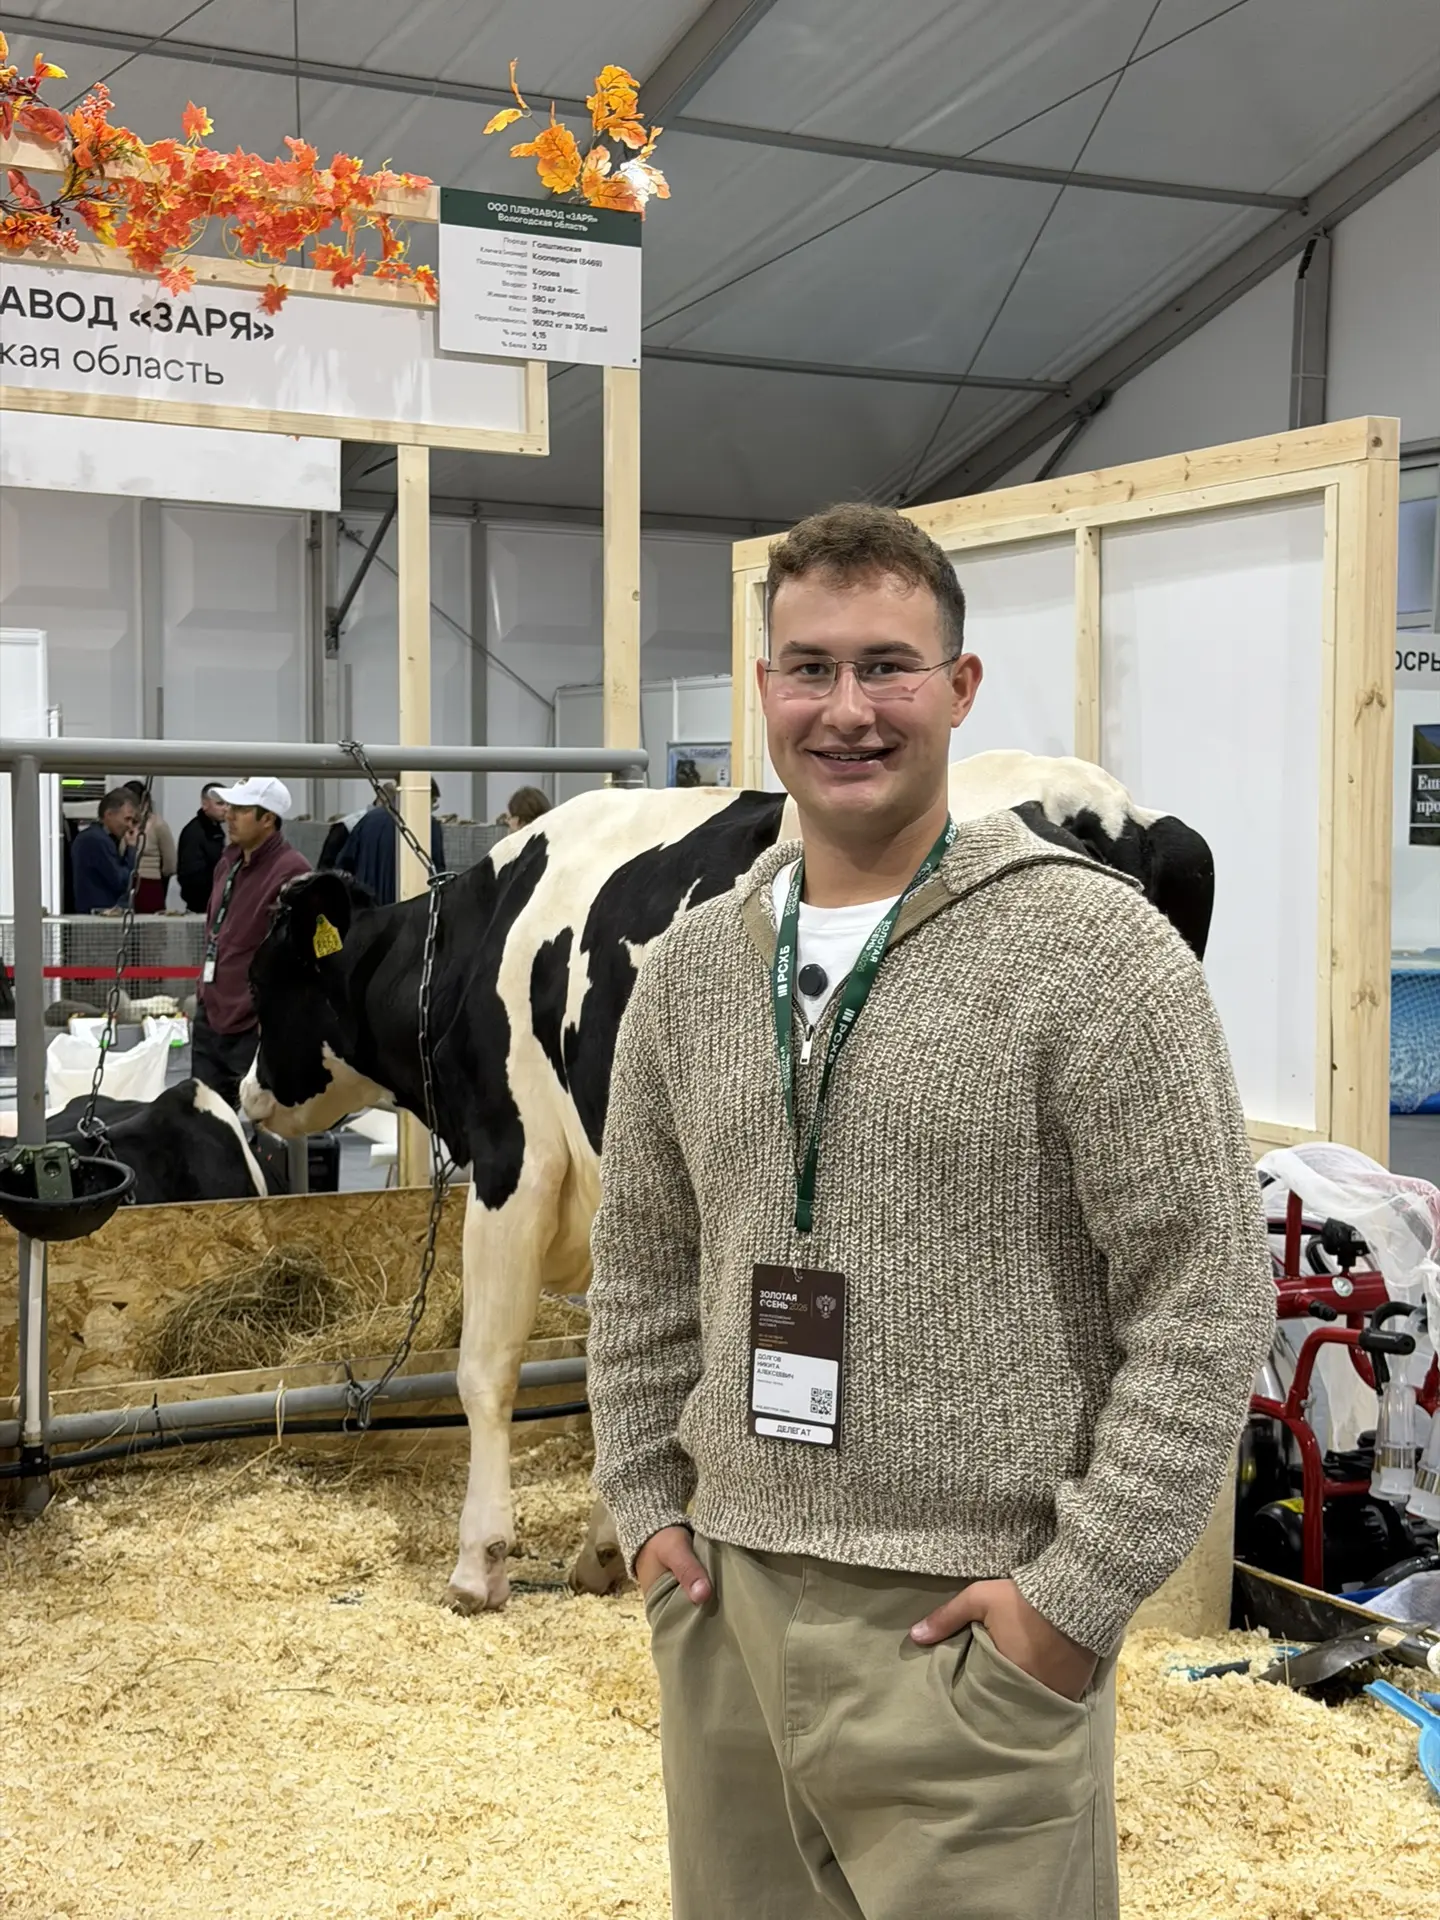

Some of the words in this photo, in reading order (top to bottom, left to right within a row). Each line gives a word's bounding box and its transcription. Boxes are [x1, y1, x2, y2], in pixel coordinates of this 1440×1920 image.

[487, 201, 508, 213] ООО
[509, 205, 566, 221] ПЛЕМЗАВОД
[498, 212, 552, 228] Вологодская
[554, 220, 588, 232] область
[532, 252, 578, 266] Кооперация
[532, 267, 560, 279] Корова
[532, 282, 537, 290] 3
[557, 284, 562, 292] 2
[129, 301, 275, 341] «ЗАРЯ»
[73, 344, 224, 386] область
[870, 920, 893, 963] ЗОЛОТАЯ
[777, 945, 790, 981] РСХБ
[827, 1023, 848, 1064] РСХБ
[759, 1290, 797, 1302] ЗОЛОТАЯ
[757, 1361, 780, 1369] НИКИТА
[776, 1424, 812, 1436] ДЕЛЕГАТ
